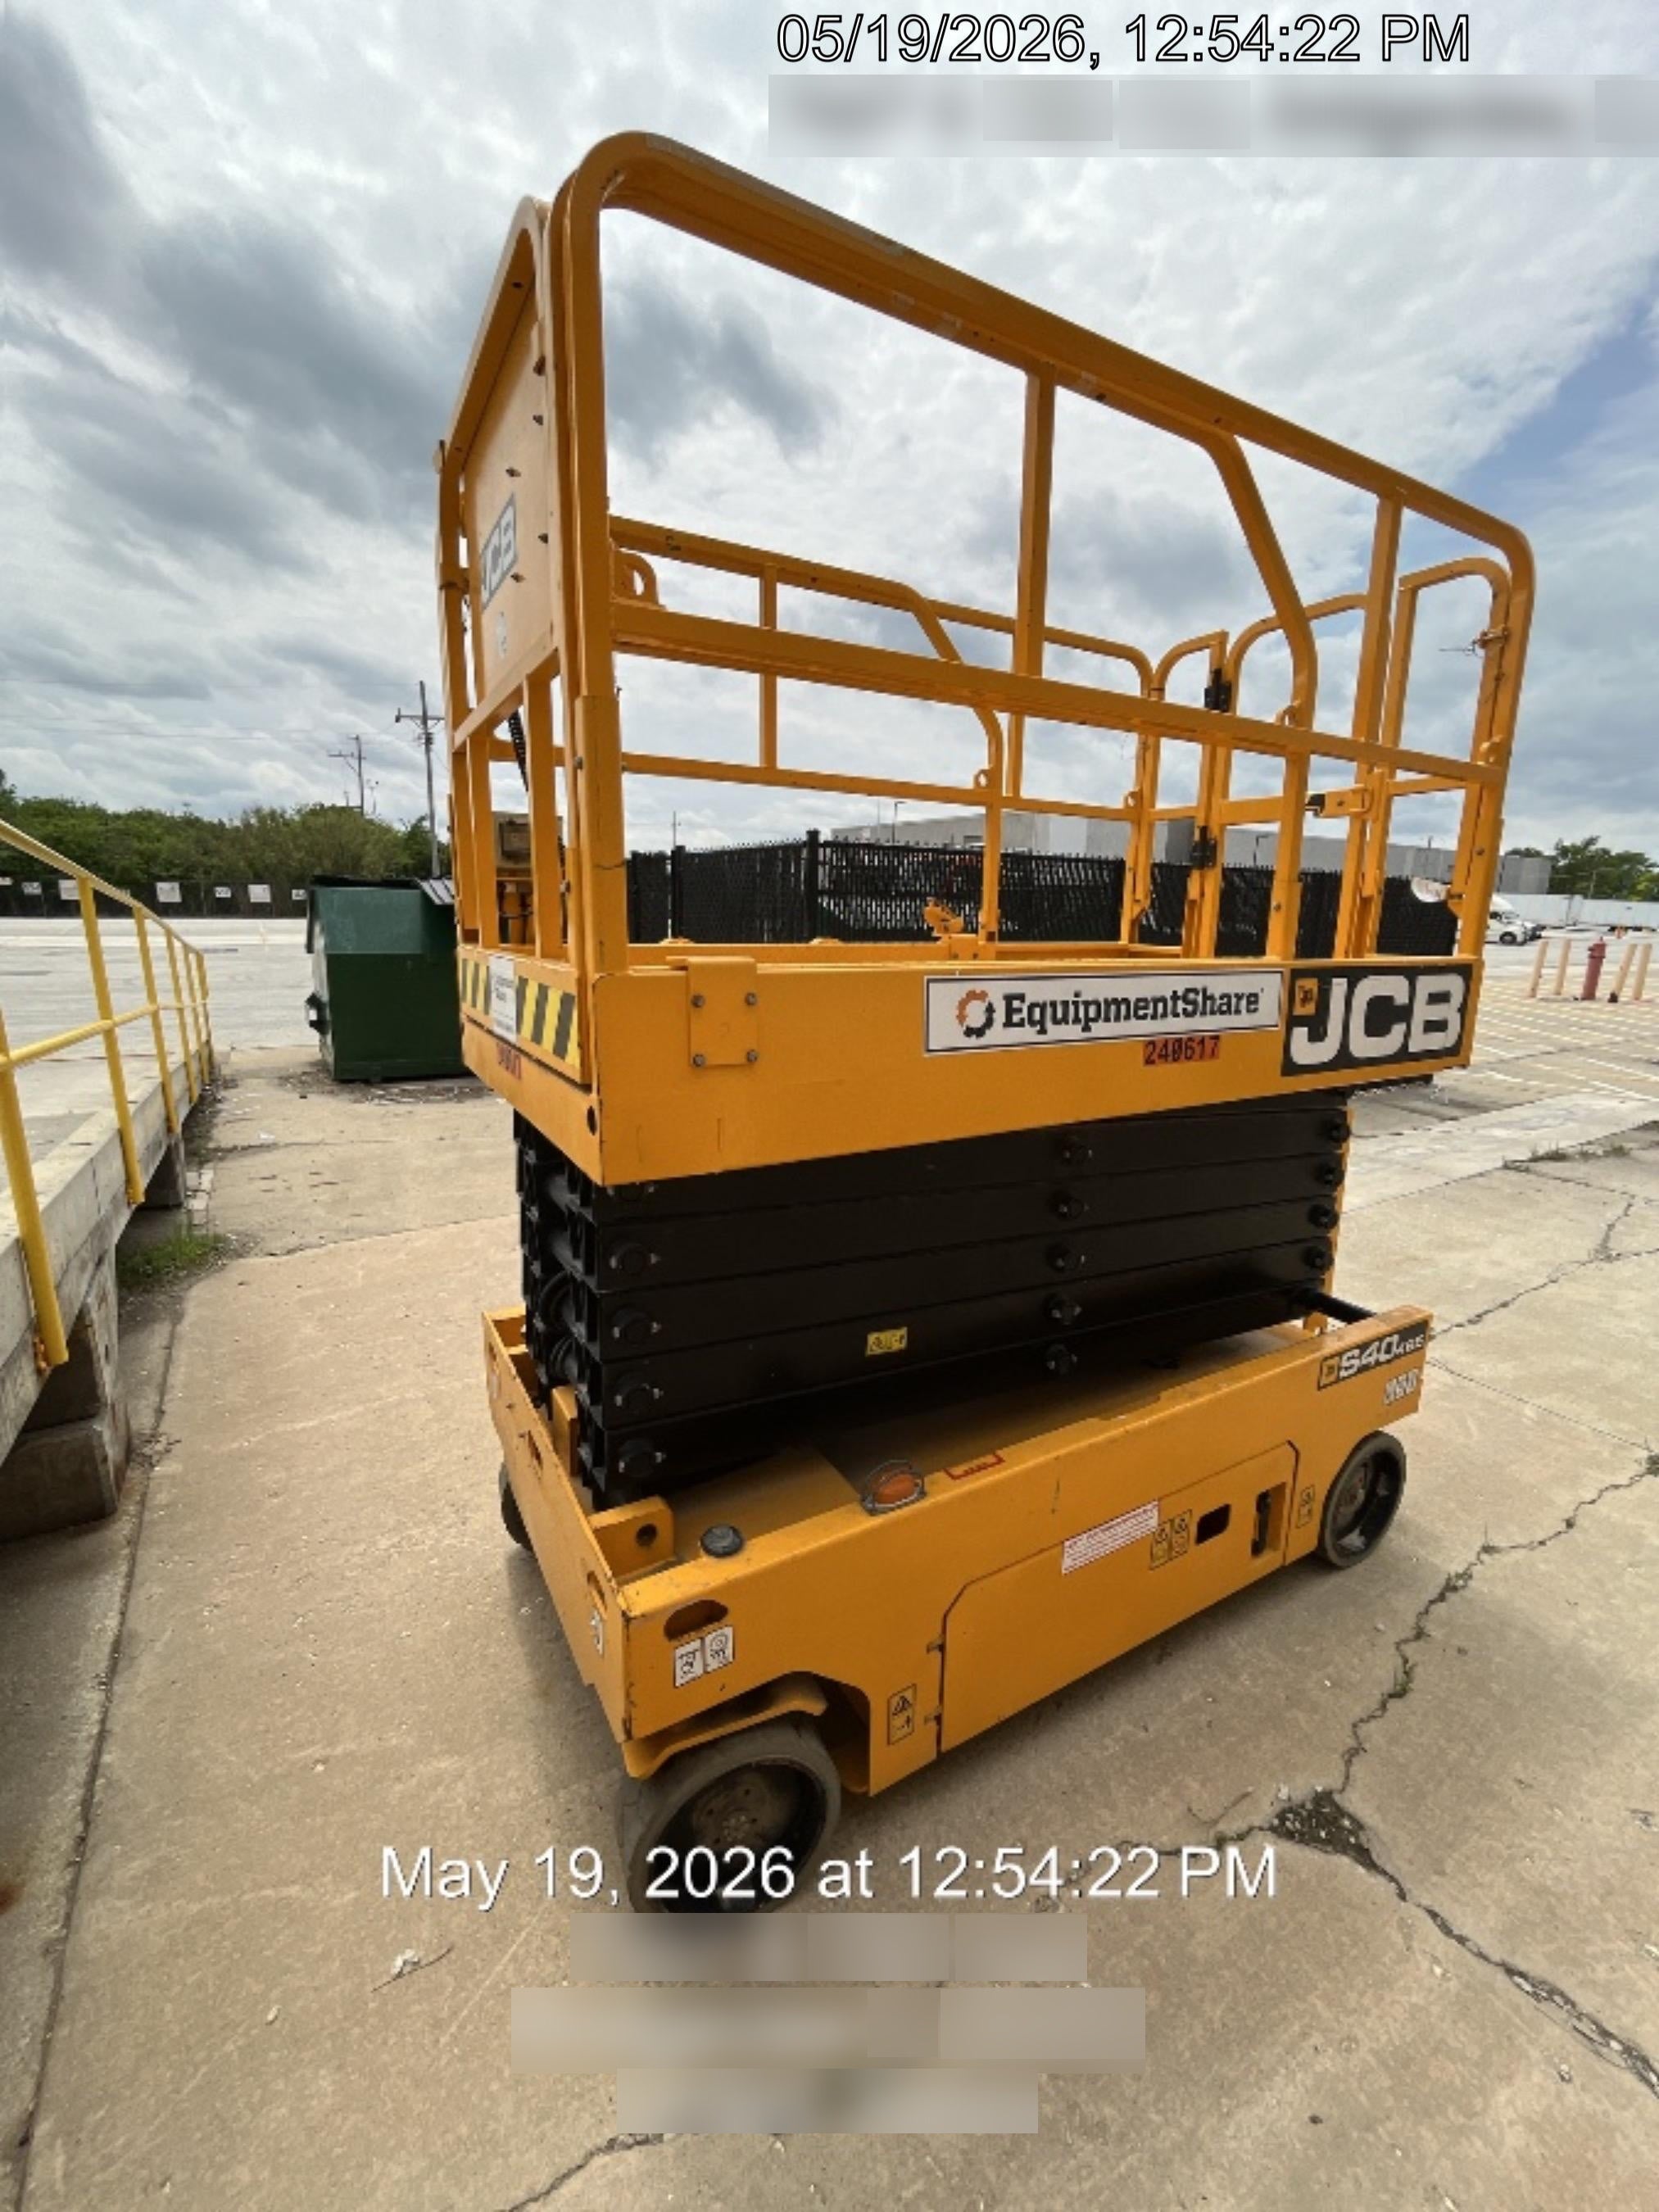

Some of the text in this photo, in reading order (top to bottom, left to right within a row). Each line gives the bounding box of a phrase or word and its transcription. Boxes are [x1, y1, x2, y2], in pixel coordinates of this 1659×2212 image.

[1002, 986, 1261, 1035] EquipmentShare
[1290, 972, 1465, 1065] JCB
[1145, 1035, 1219, 1065] 240617
